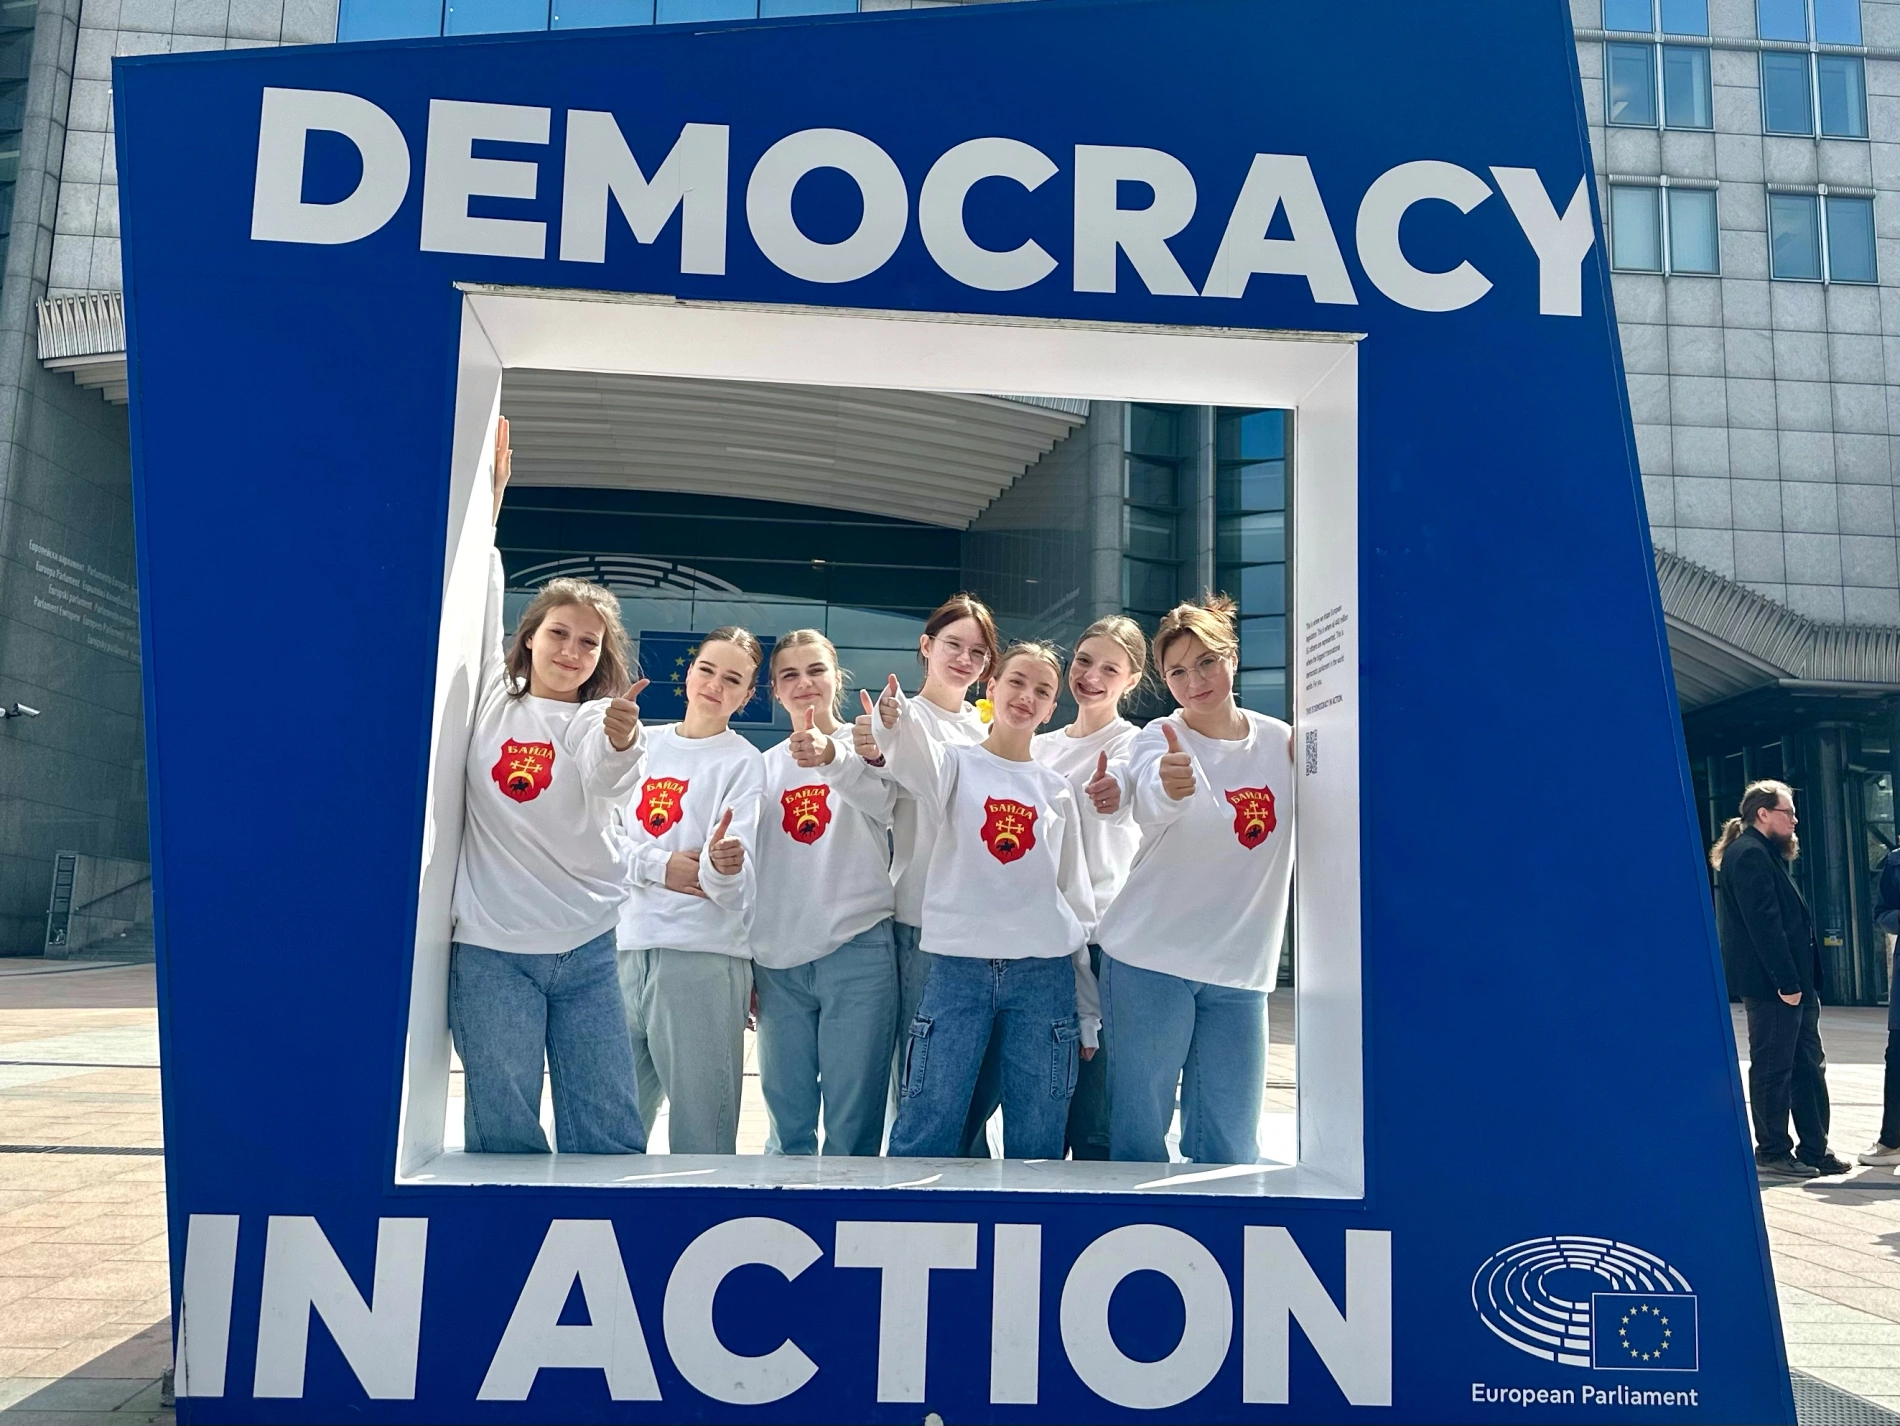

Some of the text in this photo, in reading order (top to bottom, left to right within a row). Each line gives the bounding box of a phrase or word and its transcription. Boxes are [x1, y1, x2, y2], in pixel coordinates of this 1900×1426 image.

[251, 87, 1596, 317] DEMOCRACY
[507, 745, 553, 760] БАЙДА
[646, 779, 684, 793] БАЙДА
[785, 788, 825, 804] БАЙДА
[1231, 791, 1271, 804] БАЙДА
[989, 804, 1033, 820] БАЙДА
[174, 1213, 1393, 1410] IN ACTION
[1472, 1383, 1699, 1407] European Parliament
